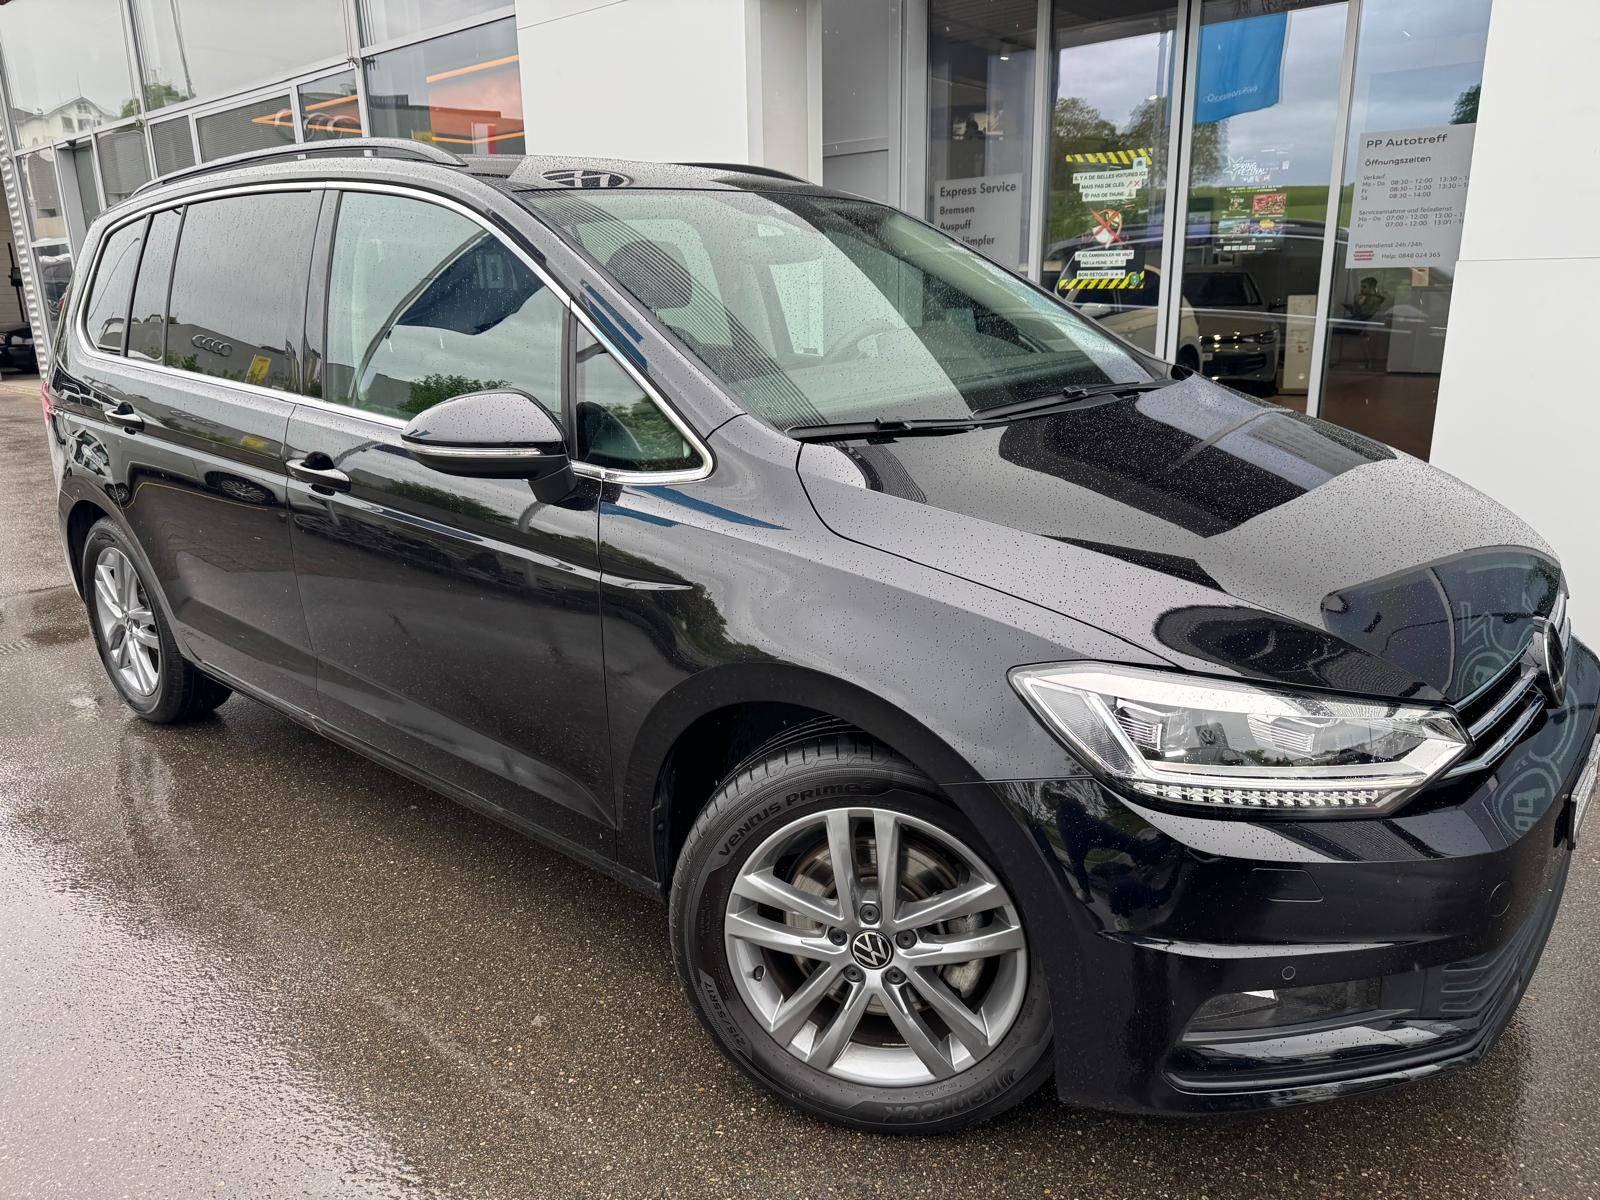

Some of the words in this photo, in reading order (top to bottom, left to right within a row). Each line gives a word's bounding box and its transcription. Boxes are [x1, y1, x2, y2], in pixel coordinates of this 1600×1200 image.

[1366, 139, 1382, 148] PP
[1385, 134, 1448, 147] Autotreff
[1365, 156, 1431, 166] Öffnungszeiten
[940, 187, 977, 199] Express
[979, 181, 1016, 194] Service
[940, 206, 975, 215] Bremsen
[940, 219, 972, 232] Auspuff
